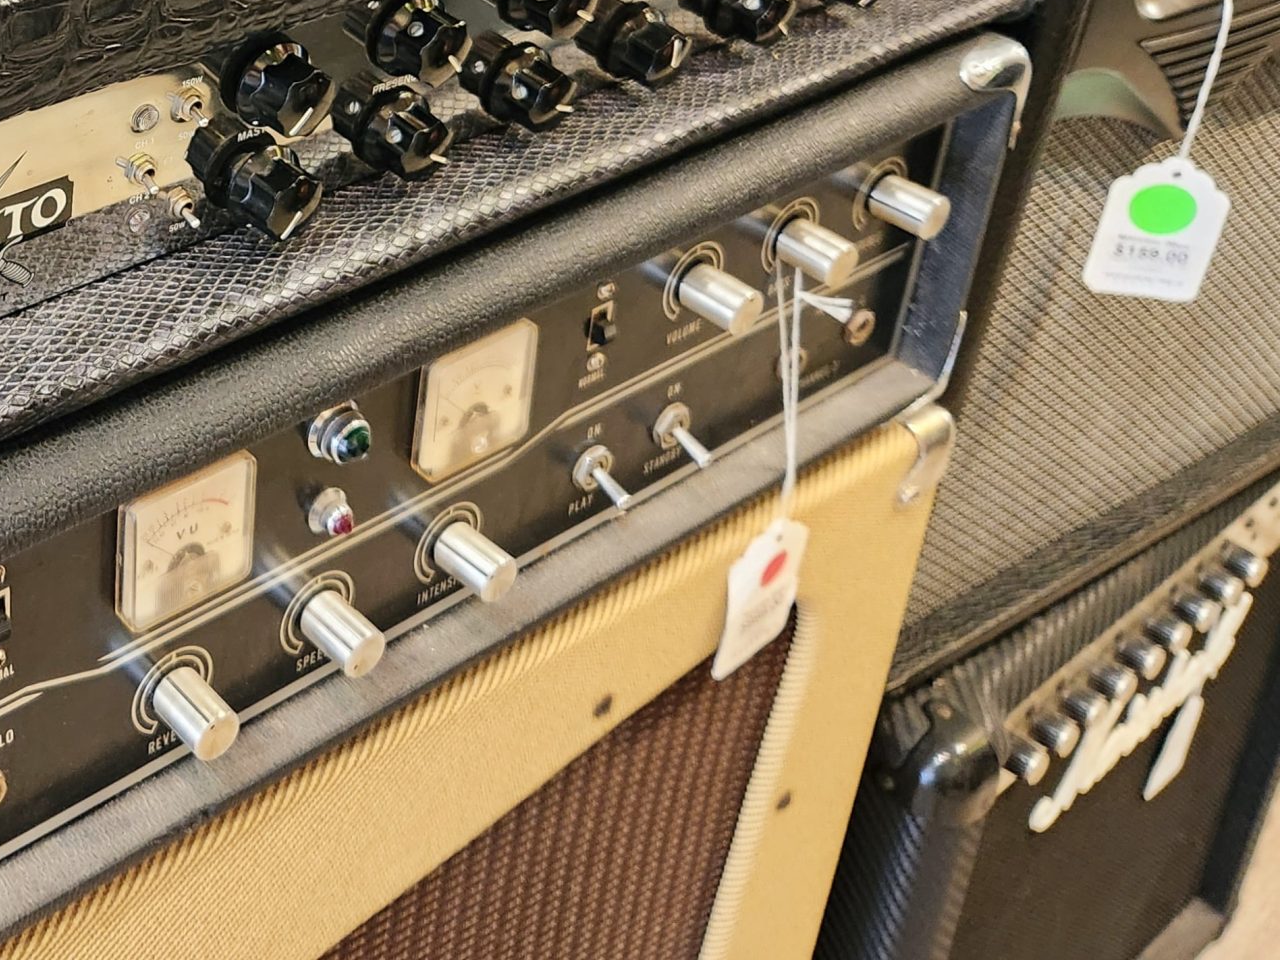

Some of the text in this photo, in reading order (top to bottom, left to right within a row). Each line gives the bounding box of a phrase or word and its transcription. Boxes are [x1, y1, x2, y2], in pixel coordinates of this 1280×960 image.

[372, 74, 418, 96] PRESEN
[237, 127, 266, 143] MAST
[666, 317, 703, 346] VOLUME
[667, 382, 682, 400] ON
[587, 422, 602, 440] ON
[568, 493, 595, 516] PLAY
[417, 575, 457, 606] INTENSI
[296, 647, 326, 672] SPEE
[148, 730, 177, 755] REVE
